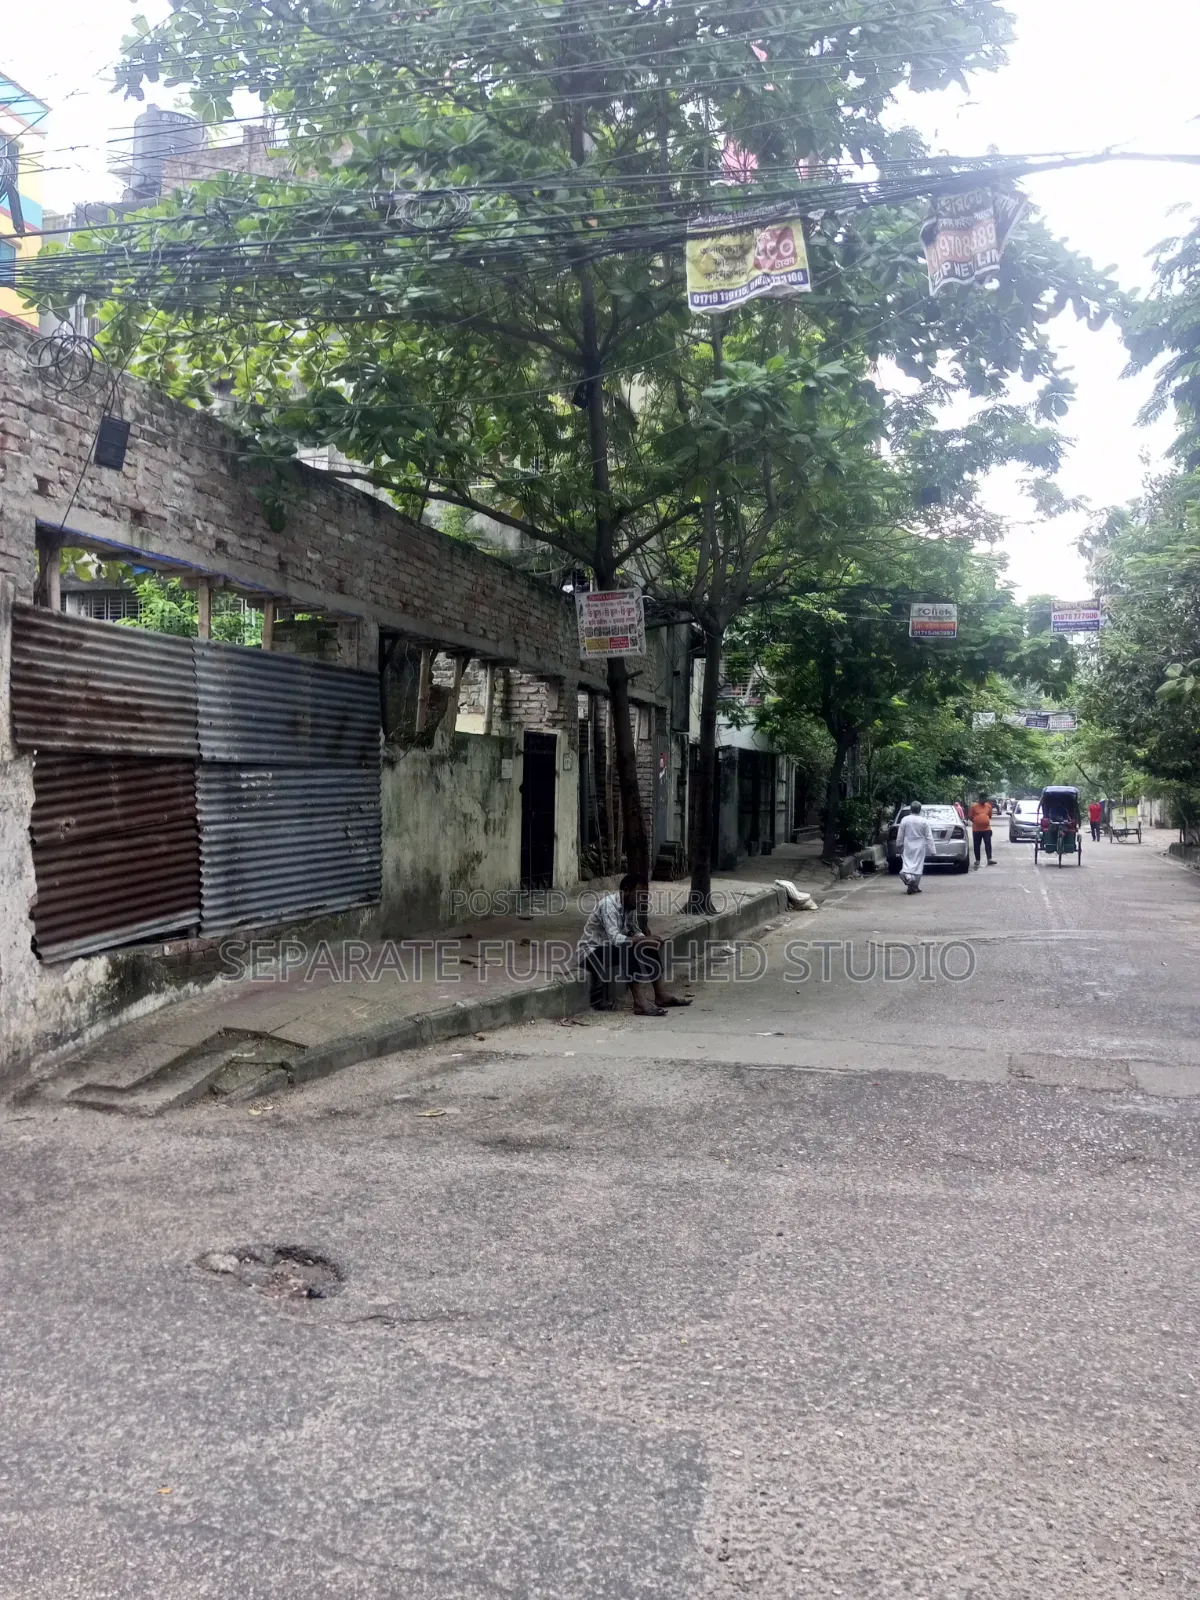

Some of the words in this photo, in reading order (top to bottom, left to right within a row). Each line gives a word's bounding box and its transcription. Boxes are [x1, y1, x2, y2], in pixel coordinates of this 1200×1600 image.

[933, 260, 952, 286] ZIP
[953, 255, 975, 277] NET
[693, 294, 718, 304] 01719
